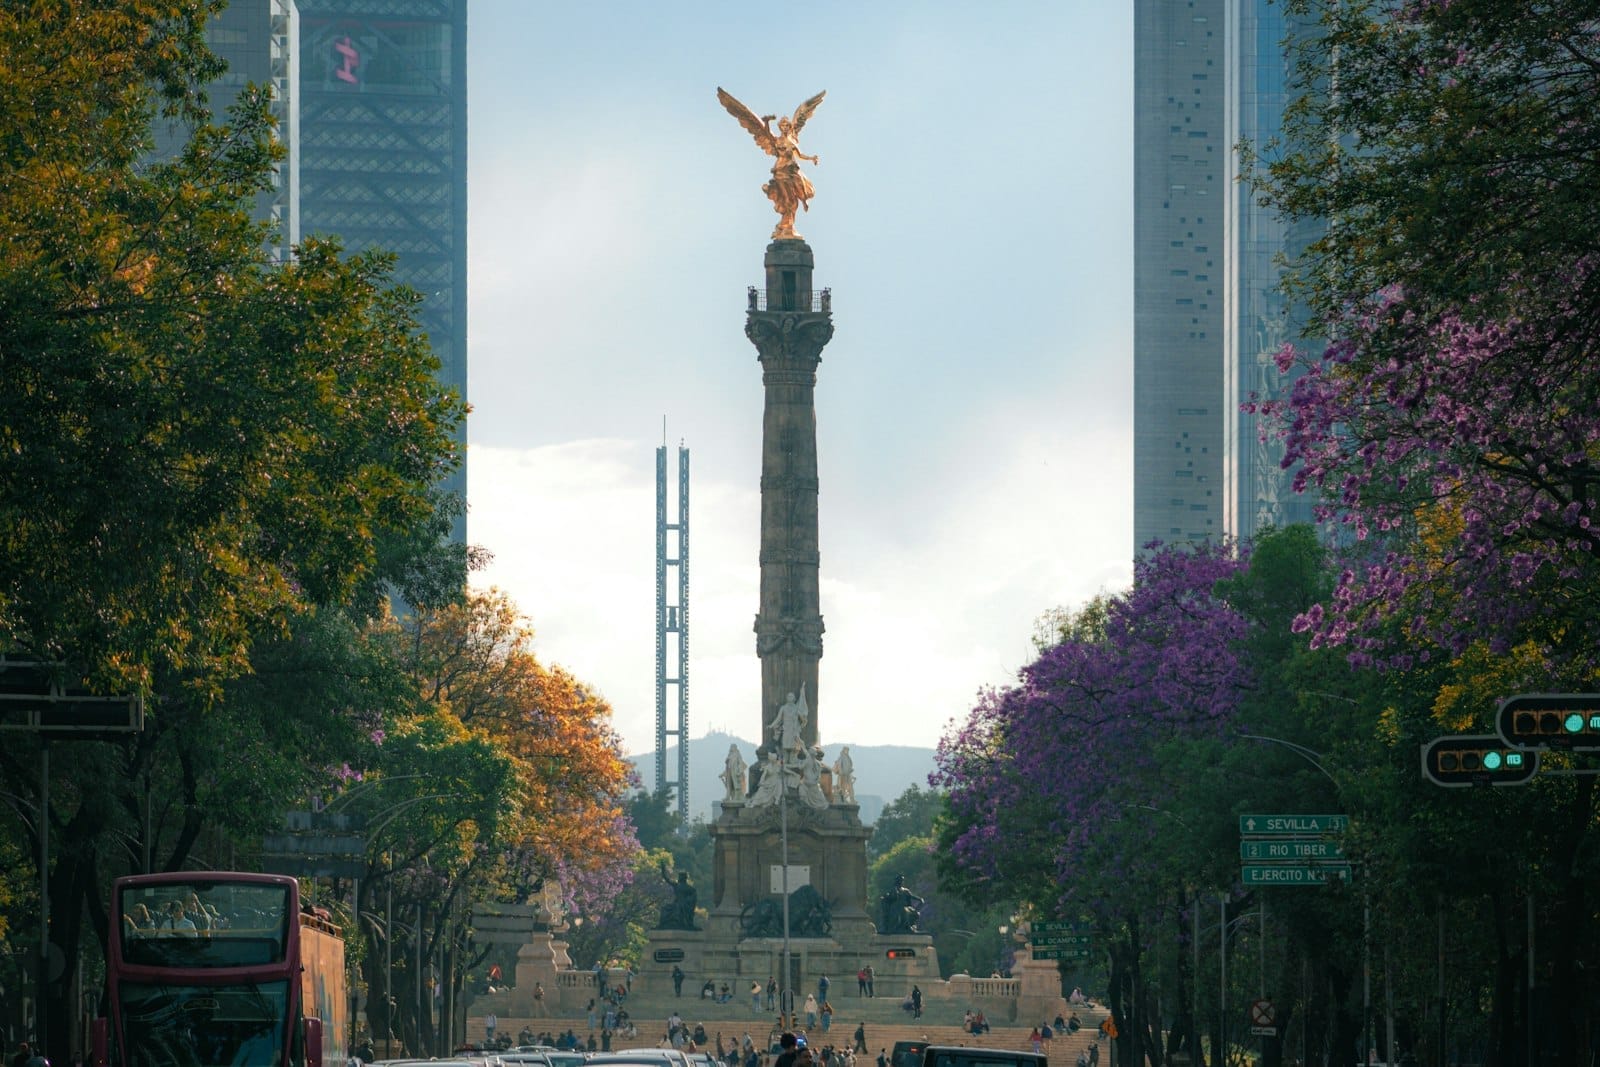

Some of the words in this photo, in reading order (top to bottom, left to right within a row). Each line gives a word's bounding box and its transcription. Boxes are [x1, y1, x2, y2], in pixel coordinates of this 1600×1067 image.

[1267, 819, 1319, 830] SEVILLA
[1250, 846, 1258, 855] 2
[1269, 844, 1289, 856] RIO
[1293, 844, 1326, 856] TIBER
[1251, 869, 1303, 881] EJERCITO
[1047, 936, 1077, 945] OCAMPO
